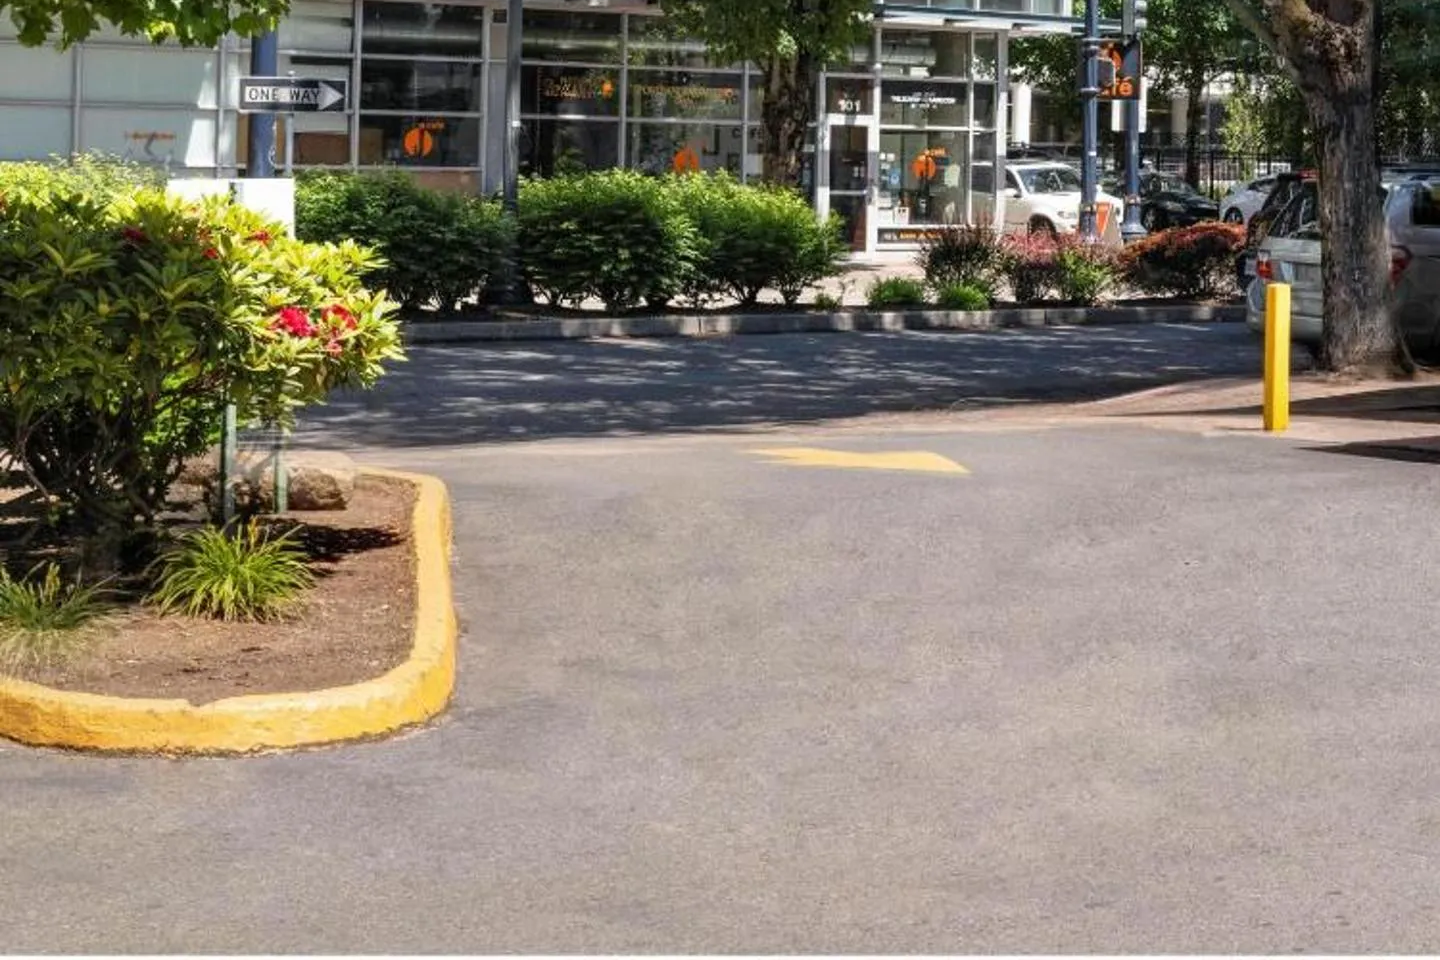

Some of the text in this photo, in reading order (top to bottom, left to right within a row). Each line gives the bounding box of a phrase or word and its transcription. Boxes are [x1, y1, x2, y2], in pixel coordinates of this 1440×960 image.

[248, 87, 320, 104] ONE WAY
[838, 99, 860, 112] 101
